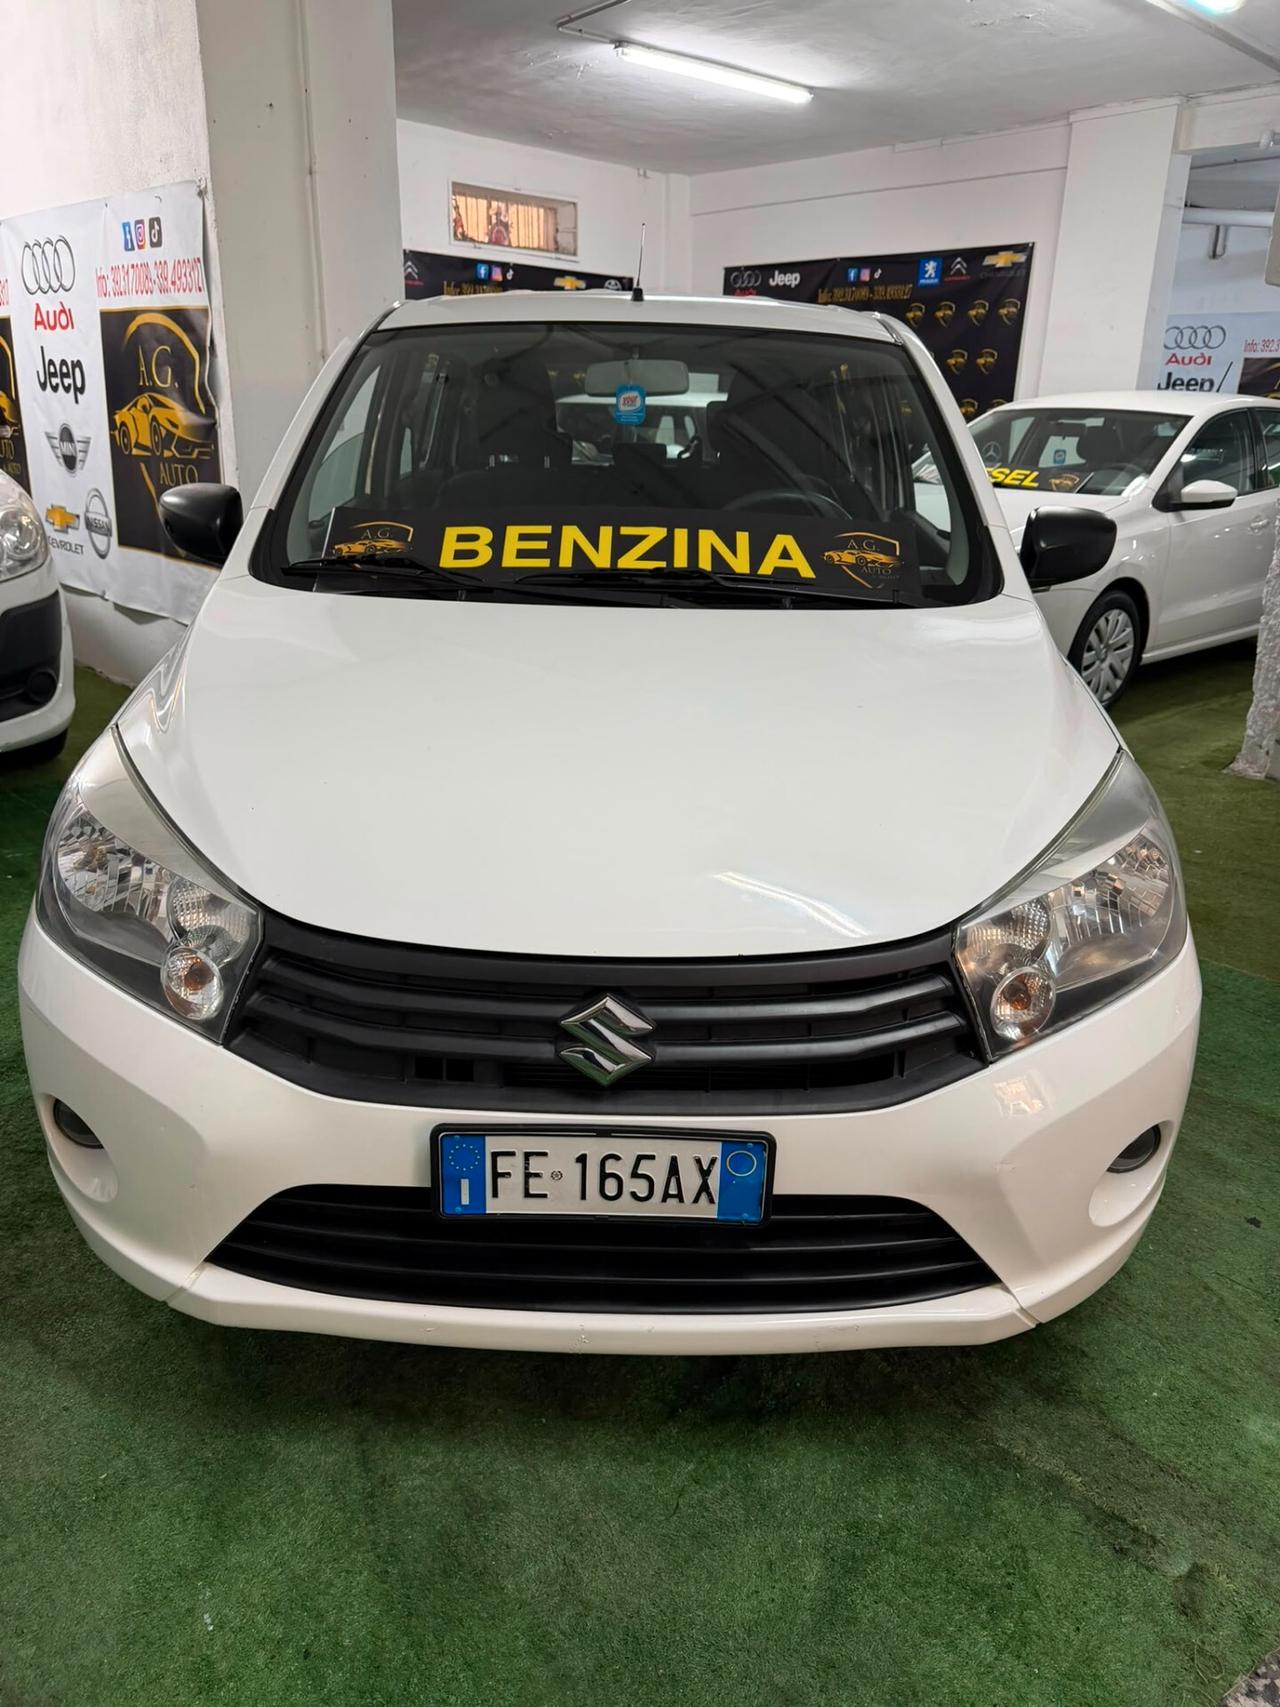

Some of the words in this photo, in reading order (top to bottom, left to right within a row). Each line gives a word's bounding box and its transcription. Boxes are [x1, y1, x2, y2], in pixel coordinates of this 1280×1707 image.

[769, 270, 800, 288] Jeep
[34, 301, 74, 331] Audi
[139, 345, 179, 389] A.G.
[1165, 352, 1212, 366] Audi
[37, 345, 86, 404] Jeep
[160, 461, 198, 487] AUTO
[439, 525, 816, 579] BENZINA
[860, 565, 892, 576] AUTO
[490, 1150, 549, 1200] FE
[574, 1152, 719, 1205] 165AX
